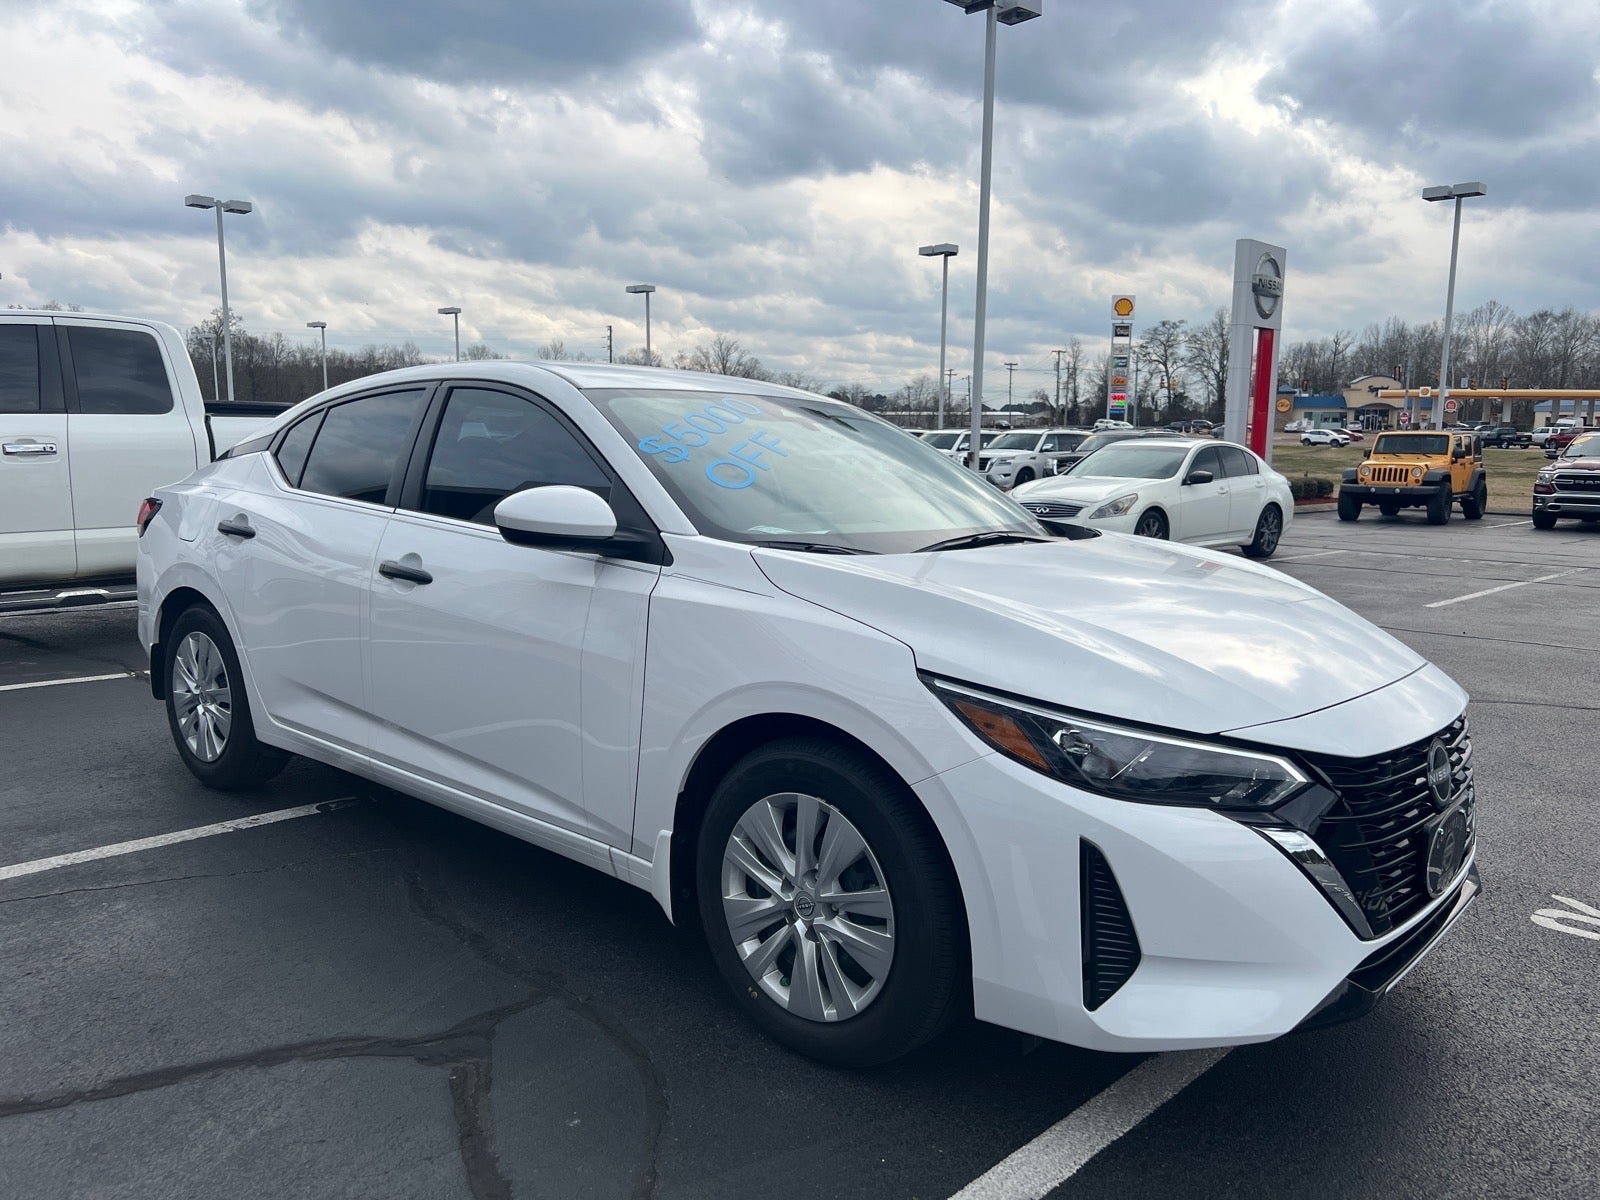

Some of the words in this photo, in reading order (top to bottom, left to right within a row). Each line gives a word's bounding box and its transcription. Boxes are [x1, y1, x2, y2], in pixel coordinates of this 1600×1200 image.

[1258, 278, 1282, 290] NISSA
[638, 397, 761, 463] $5000
[705, 429, 788, 489] OFF
[1429, 767, 1449, 784] NISS
